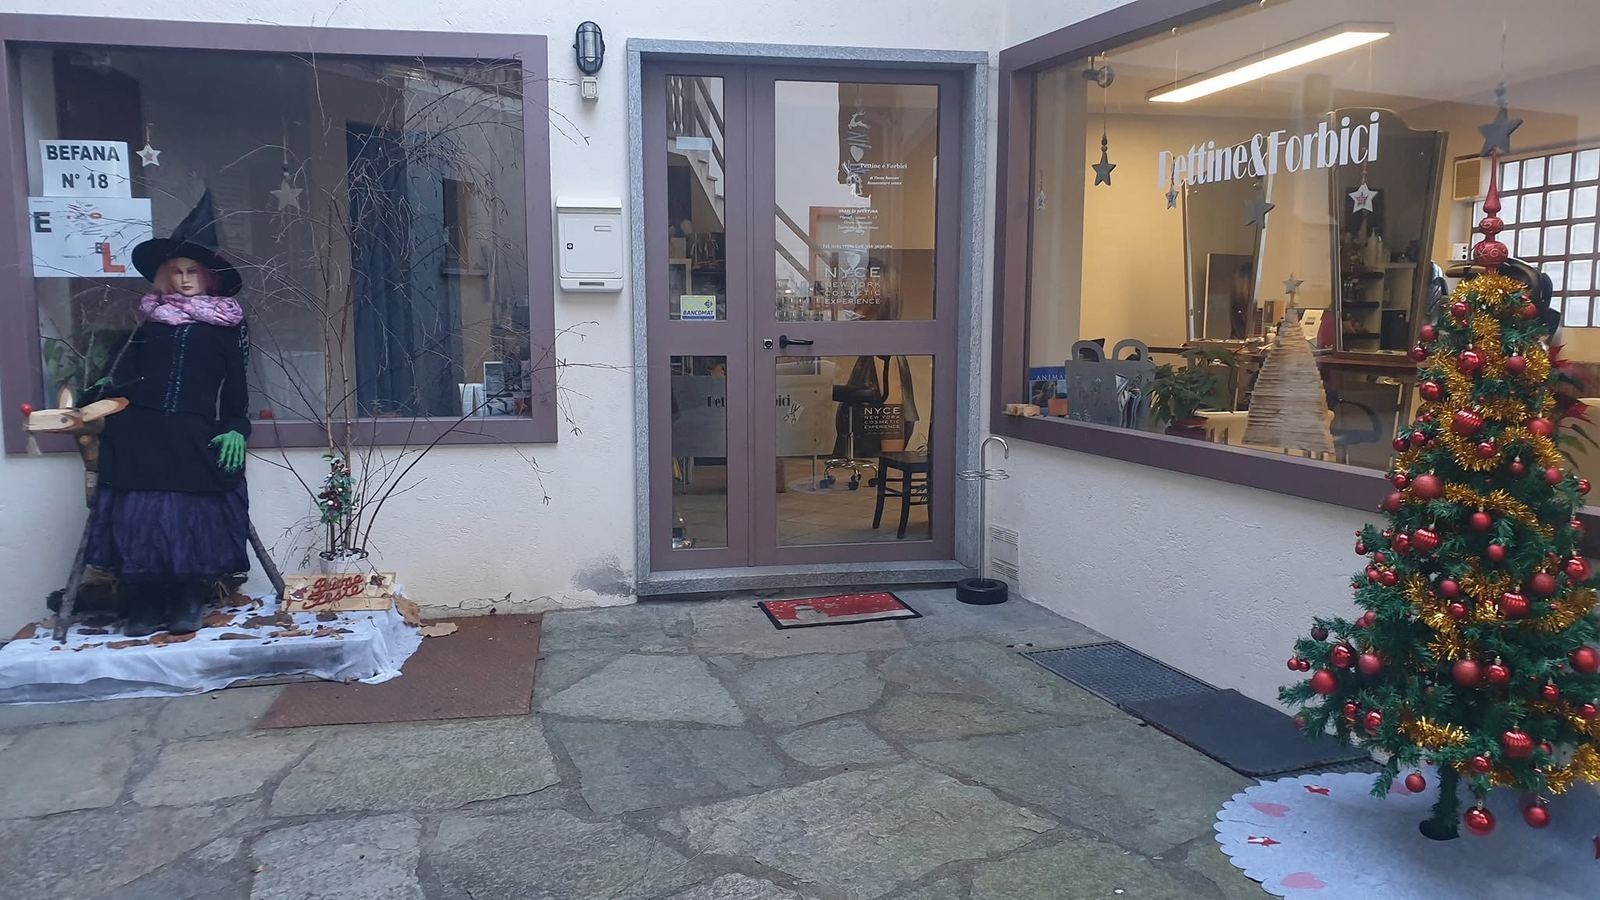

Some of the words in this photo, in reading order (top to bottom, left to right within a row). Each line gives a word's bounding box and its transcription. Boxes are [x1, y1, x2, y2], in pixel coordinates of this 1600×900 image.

[46, 145, 120, 161] BEFANA
[1158, 111, 1380, 189] Pettine&Forbici
[87, 172, 108, 189] 18
[825, 266, 881, 278] NYCE
[864, 407, 900, 415] NYCE
